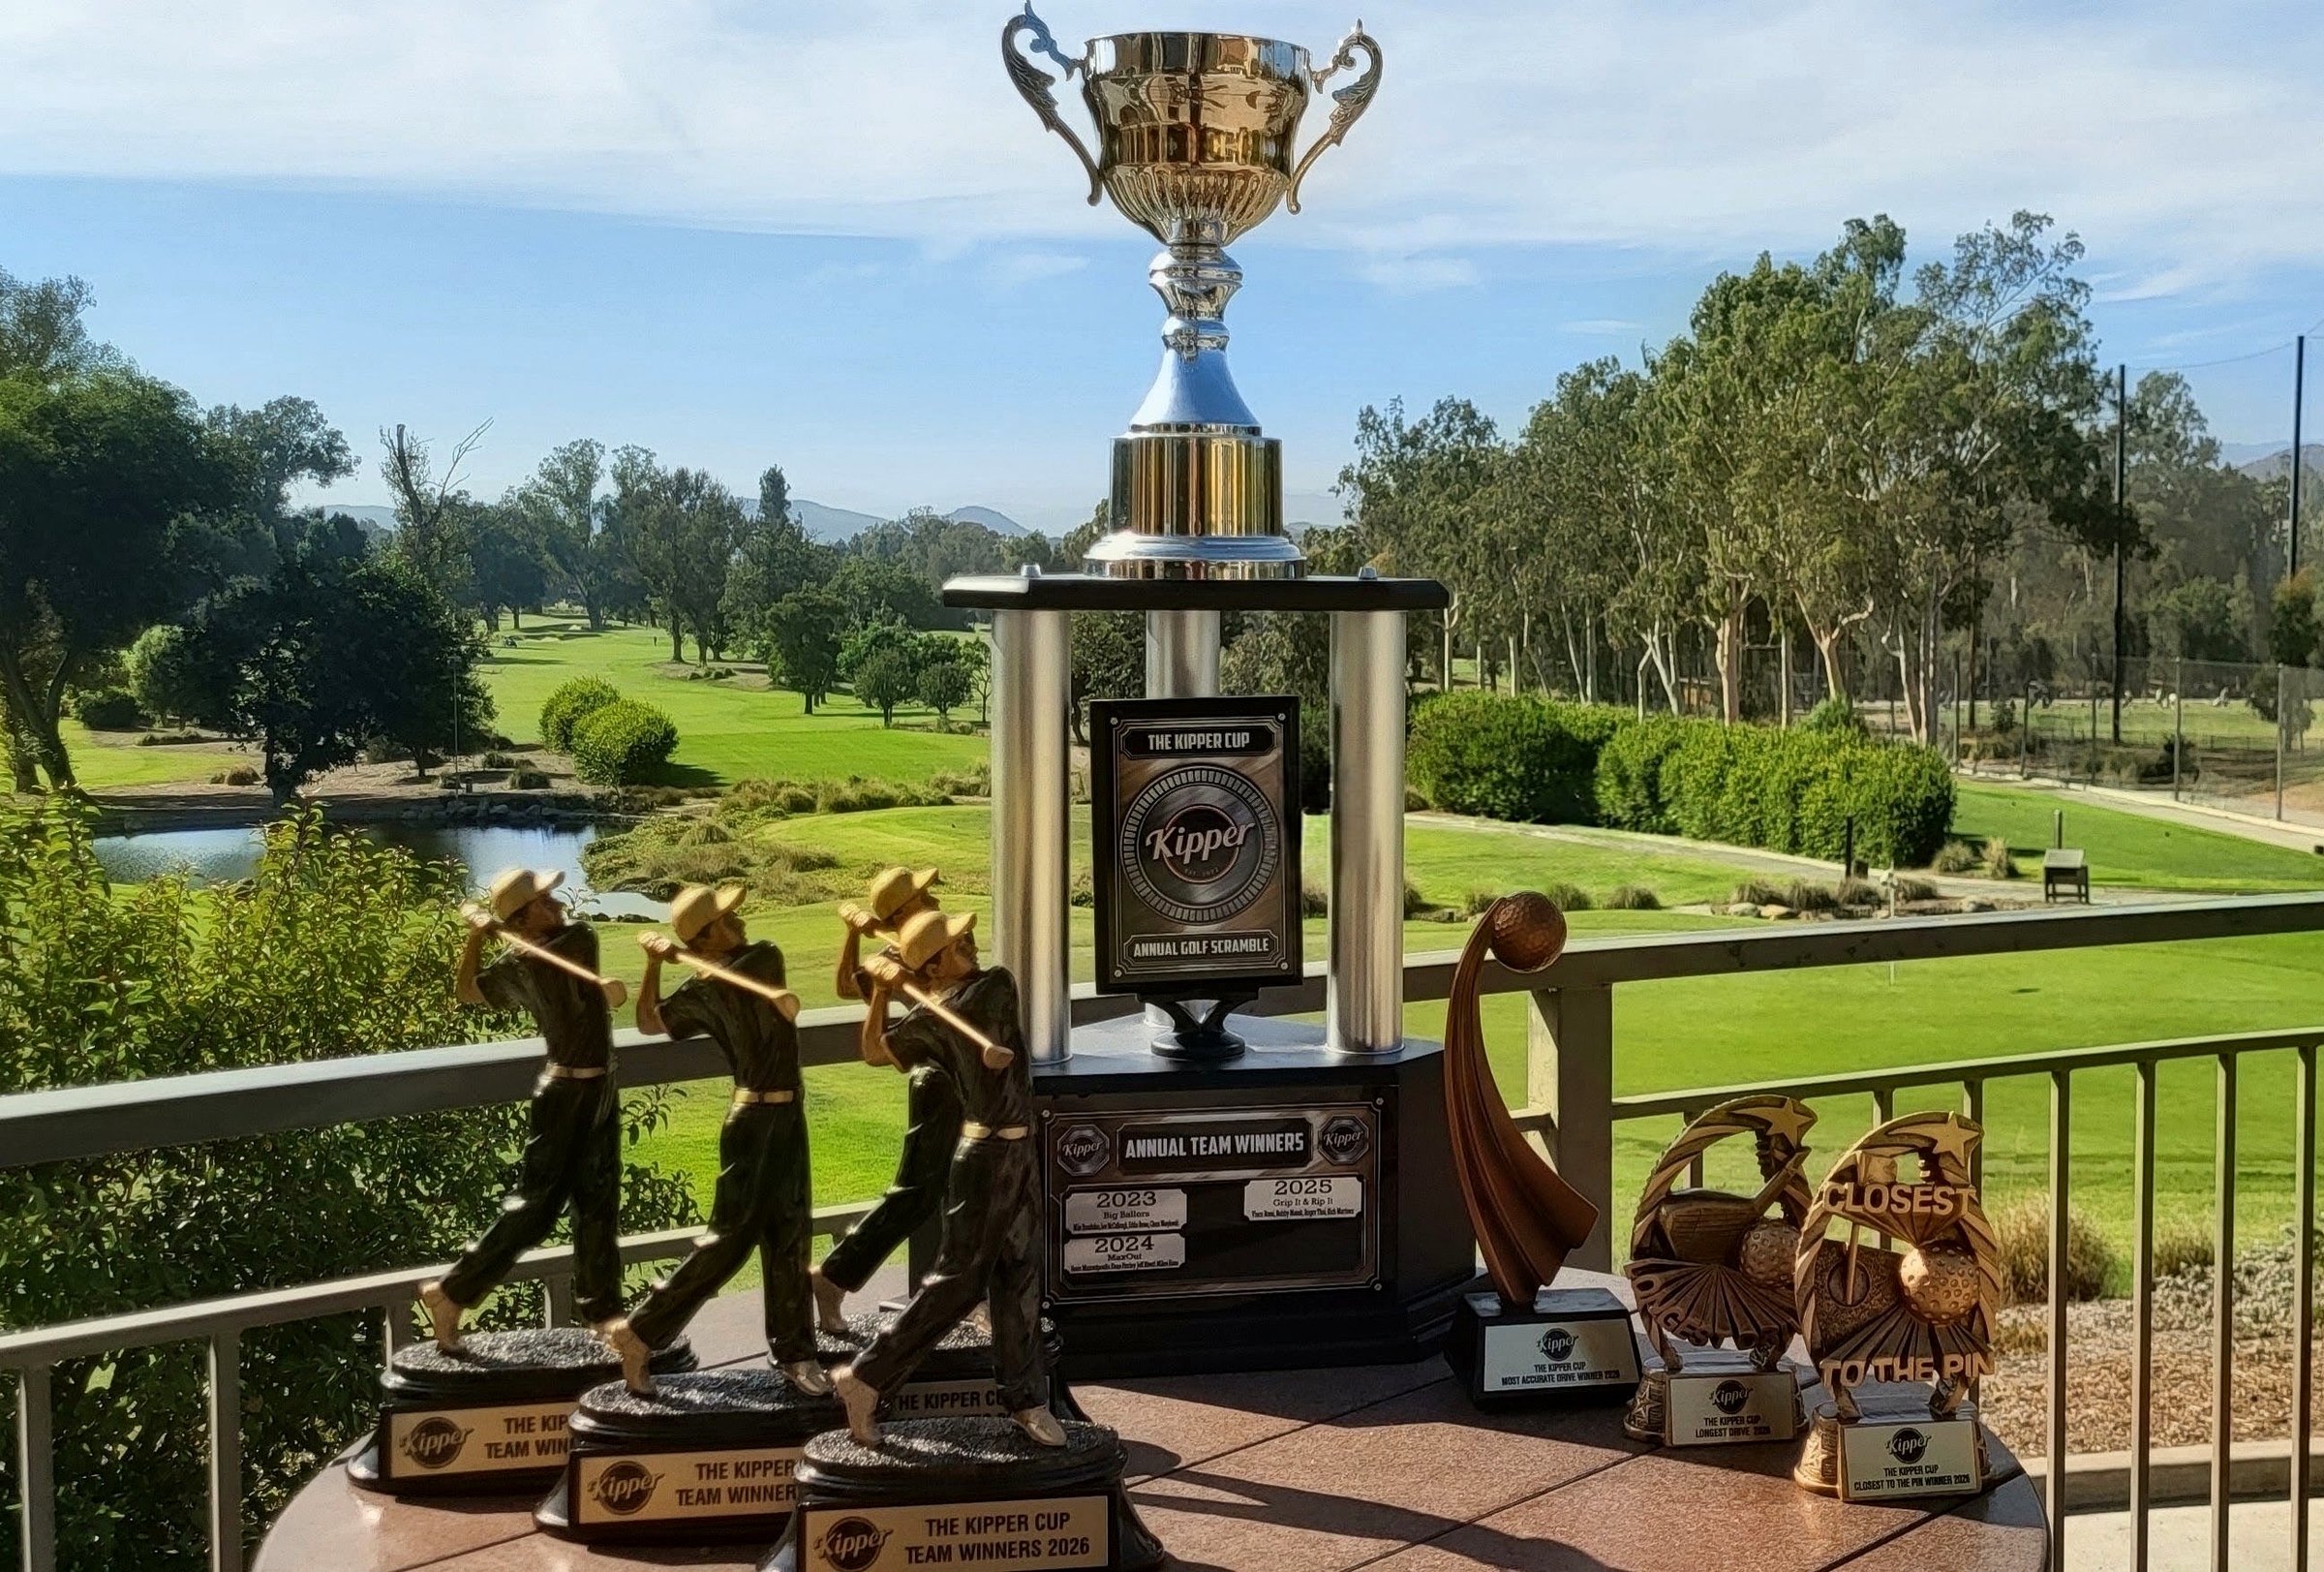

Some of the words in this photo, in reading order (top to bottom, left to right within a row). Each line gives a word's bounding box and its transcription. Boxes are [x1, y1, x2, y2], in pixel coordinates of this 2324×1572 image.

[1148, 734, 1172, 750] THE
[1175, 733, 1222, 750] KIPPER
[1224, 732, 1250, 748] CUP
[1146, 822, 1256, 865] Kipper
[1133, 941, 1178, 957] ANNUAL
[1181, 940, 1208, 955] GOLF
[1210, 938, 1269, 954] SCRAMBLE
[1062, 1140, 1104, 1156] Kipper
[1125, 1139, 1186, 1158] ANNUAL
[1190, 1136, 1232, 1156] TEAM
[1235, 1133, 1304, 1154] WINNERS
[1324, 1130, 1364, 1148] Kipper
[1274, 1180, 1332, 1195] 2025
[1096, 1191, 1157, 1209] 2023
[1272, 1198, 1294, 1208] Grip
[1311, 1197, 1326, 1207] Rip
[1822, 1182, 1976, 1216] CLOSEST
[1104, 1212, 1117, 1220] Big
[1095, 1236, 1154, 1253] 2024
[1537, 1336, 1578, 1353] Kipper
[1534, 1364, 1547, 1372] THE
[1548, 1363, 1571, 1372] KIPPER
[1573, 1362, 1586, 1371] CUP
[1819, 1360, 1865, 1388] TO
[1872, 1356, 1934, 1383] THE
[1943, 1352, 1995, 1379] PIN
[1501, 1376, 1520, 1386] MOST
[1522, 1373, 1555, 1385] ACCURATE
[1557, 1373, 1576, 1382] DRIVE
[1578, 1372, 1604, 1381] WINNER
[896, 1394, 919, 1410] HE
[924, 1391, 980, 1409] KIPPER
[1709, 1387, 1754, 1405] Kipper
[504, 1416, 535, 1434] THE
[1704, 1417, 1718, 1426] THE
[1720, 1416, 1745, 1426] KIPPER
[1746, 1415, 1760, 1424] CUP
[1696, 1428, 1728, 1437] LONGEST
[1729, 1426, 1751, 1435] DRIVE
[399, 1428, 474, 1457] Kipper
[484, 1440, 530, 1459] TEAM
[1885, 1435, 1932, 1455] Kipper
[695, 1463, 728, 1481] THE
[734, 1459, 795, 1479] KIPPER
[1883, 1467, 1897, 1477] THE
[1899, 1465, 1923, 1476] KIPPER
[1925, 1464, 1939, 1474] CUP
[587, 1473, 666, 1502] Kipper
[1854, 1480, 1884, 1491] CLOSEST
[1886, 1479, 1895, 1489] TO
[1896, 1478, 1910, 1488] THE
[1911, 1477, 1923, 1487] PIN
[1925, 1475, 1952, 1486] WINNER
[676, 1488, 720, 1506] TEAM
[728, 1484, 798, 1504] WINNER
[926, 1518, 959, 1537] THE
[964, 1514, 1028, 1534] KIPPER
[1035, 1512, 1071, 1530] CUP
[813, 1529, 894, 1560] Kipper
[904, 1545, 952, 1565] TEAM
[959, 1541, 1042, 1561] WINNERS
[1048, 1537, 1090, 1557] 2026
